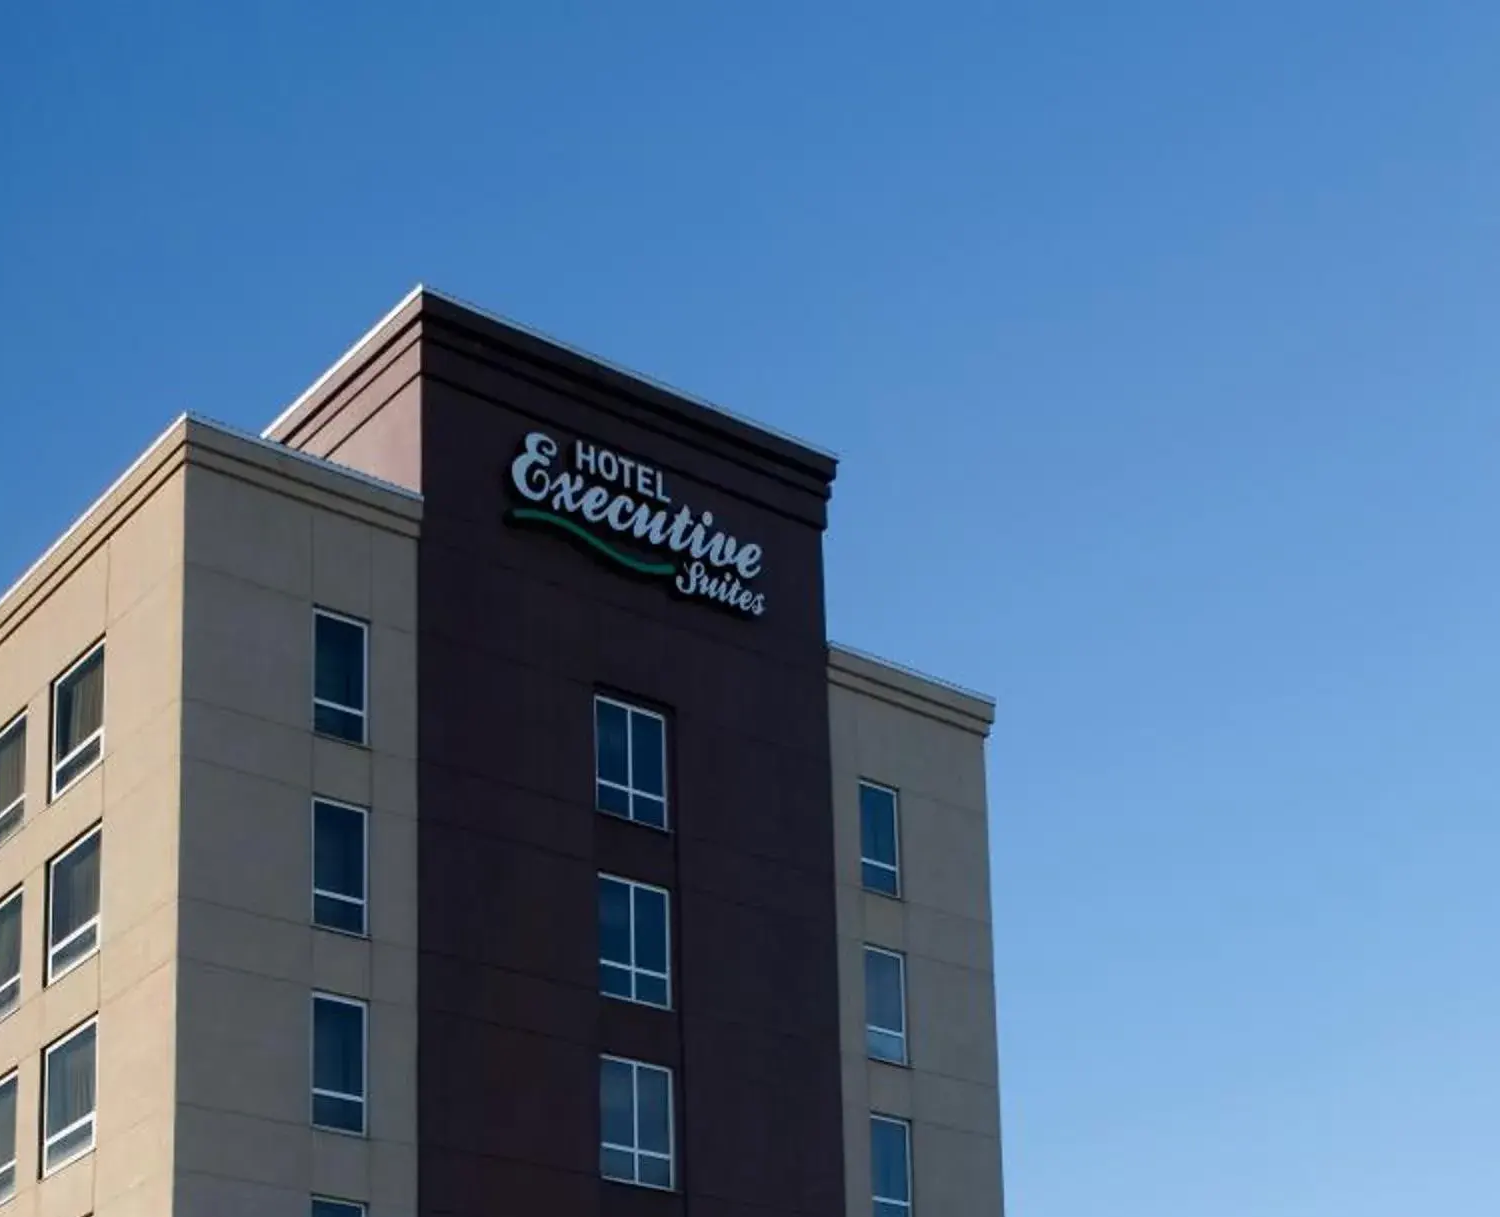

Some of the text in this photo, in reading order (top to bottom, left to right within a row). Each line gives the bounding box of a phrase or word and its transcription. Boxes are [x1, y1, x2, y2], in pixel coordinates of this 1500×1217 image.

[574, 439, 672, 503] HOTEL
[511, 431, 763, 579] Executive
[675, 561, 766, 615] Suites
